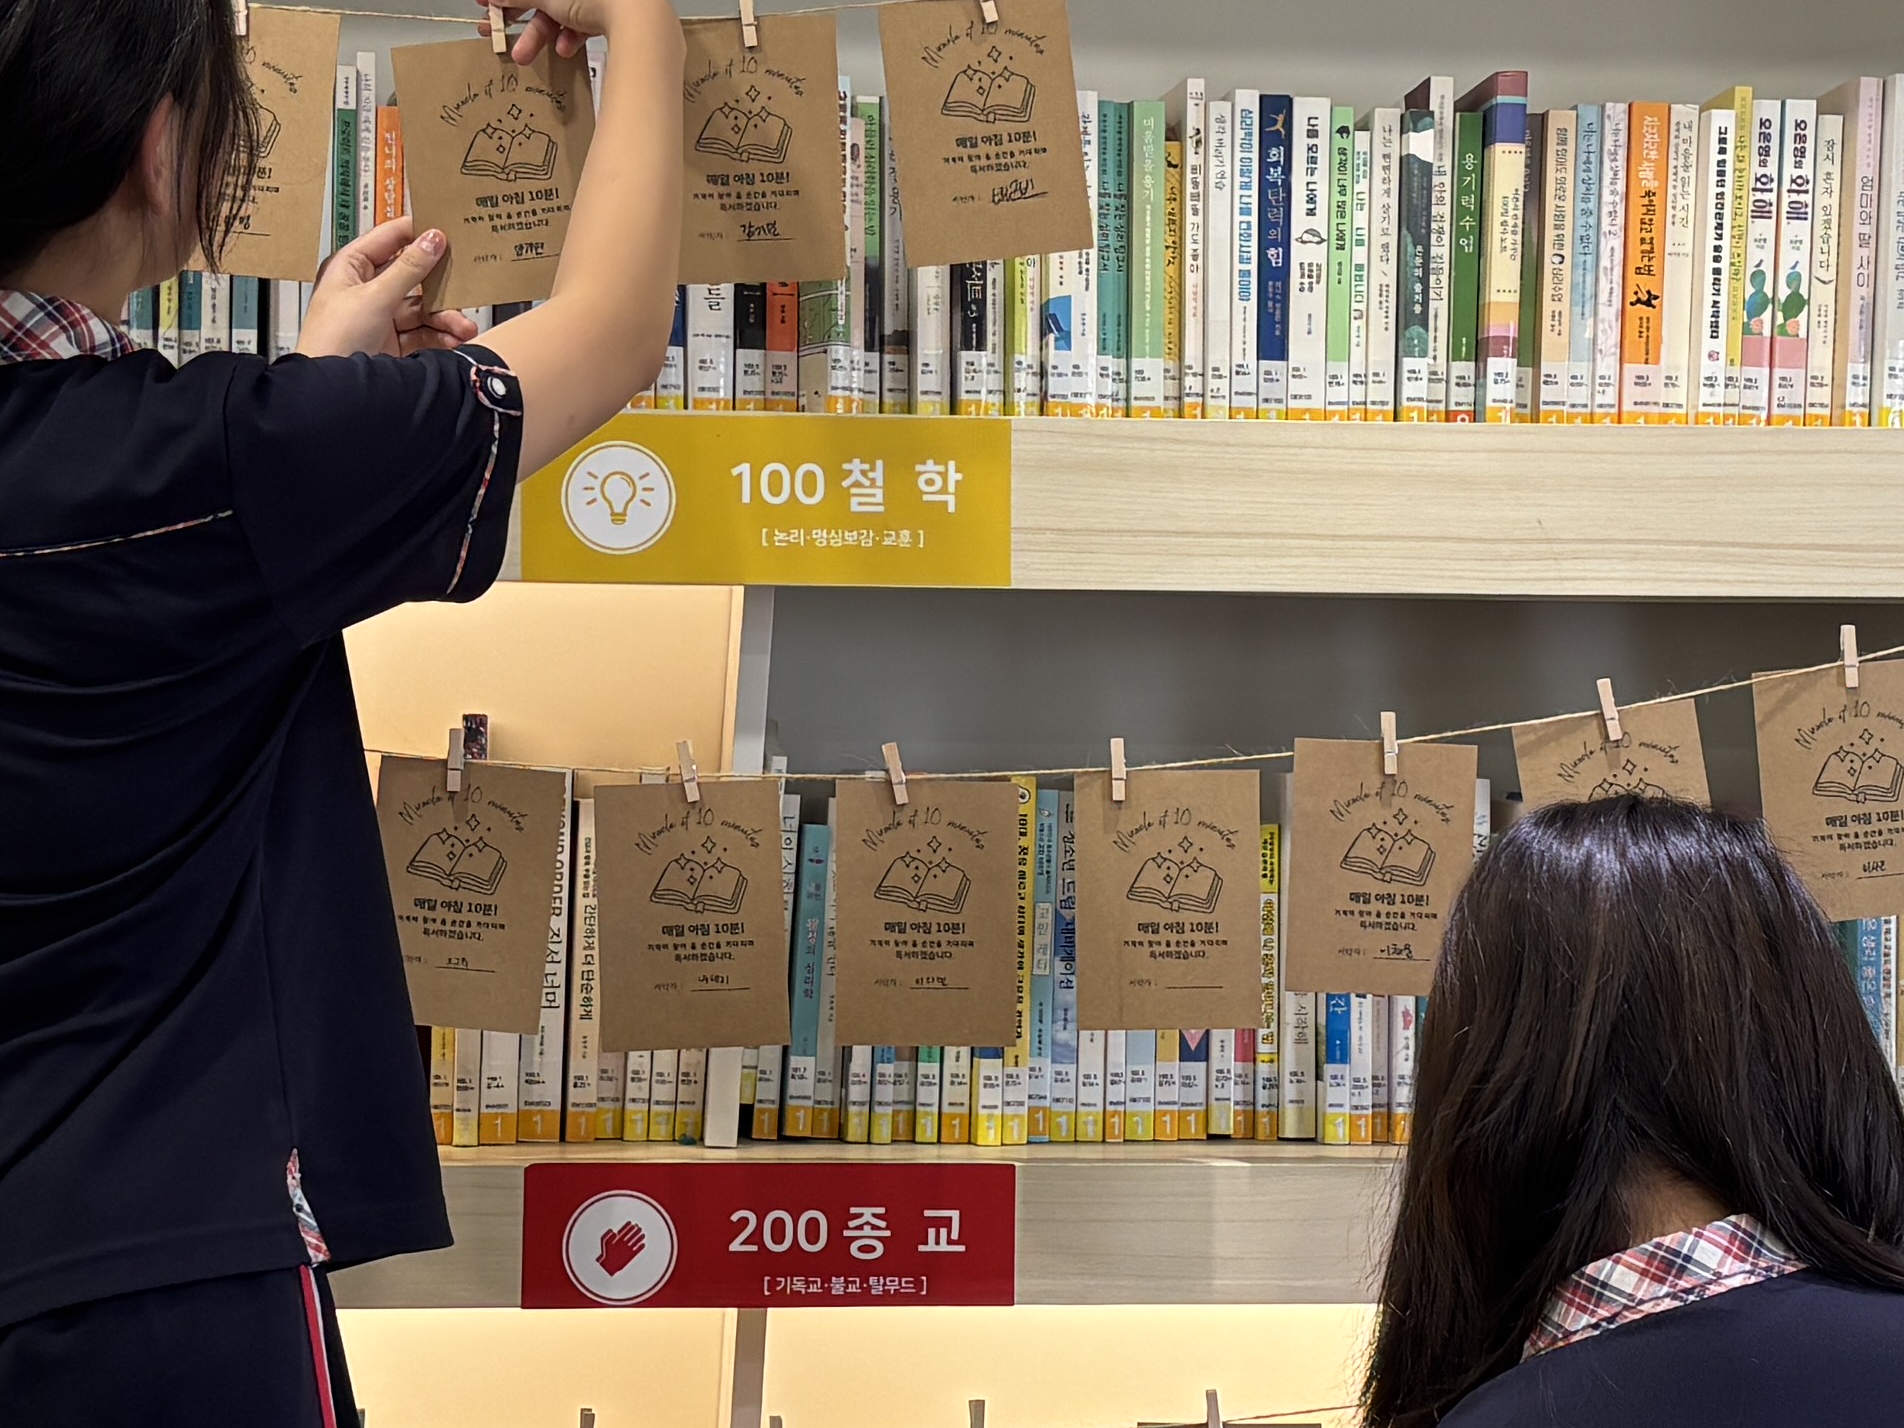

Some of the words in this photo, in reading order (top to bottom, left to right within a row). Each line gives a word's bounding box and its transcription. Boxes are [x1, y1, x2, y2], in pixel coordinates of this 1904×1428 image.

[1306, 117, 1318, 139] 나를
[1794, 118, 1807, 169] 오은영의
[1306, 144, 1318, 176] 모르는
[1306, 181, 1318, 216] 나에게
[731, 462, 825, 505] 100
[582, 904, 595, 951] 간단하게
[582, 954, 594, 966] 더
[580, 969, 594, 1020] 단순하게
[728, 1210, 828, 1252] 200
